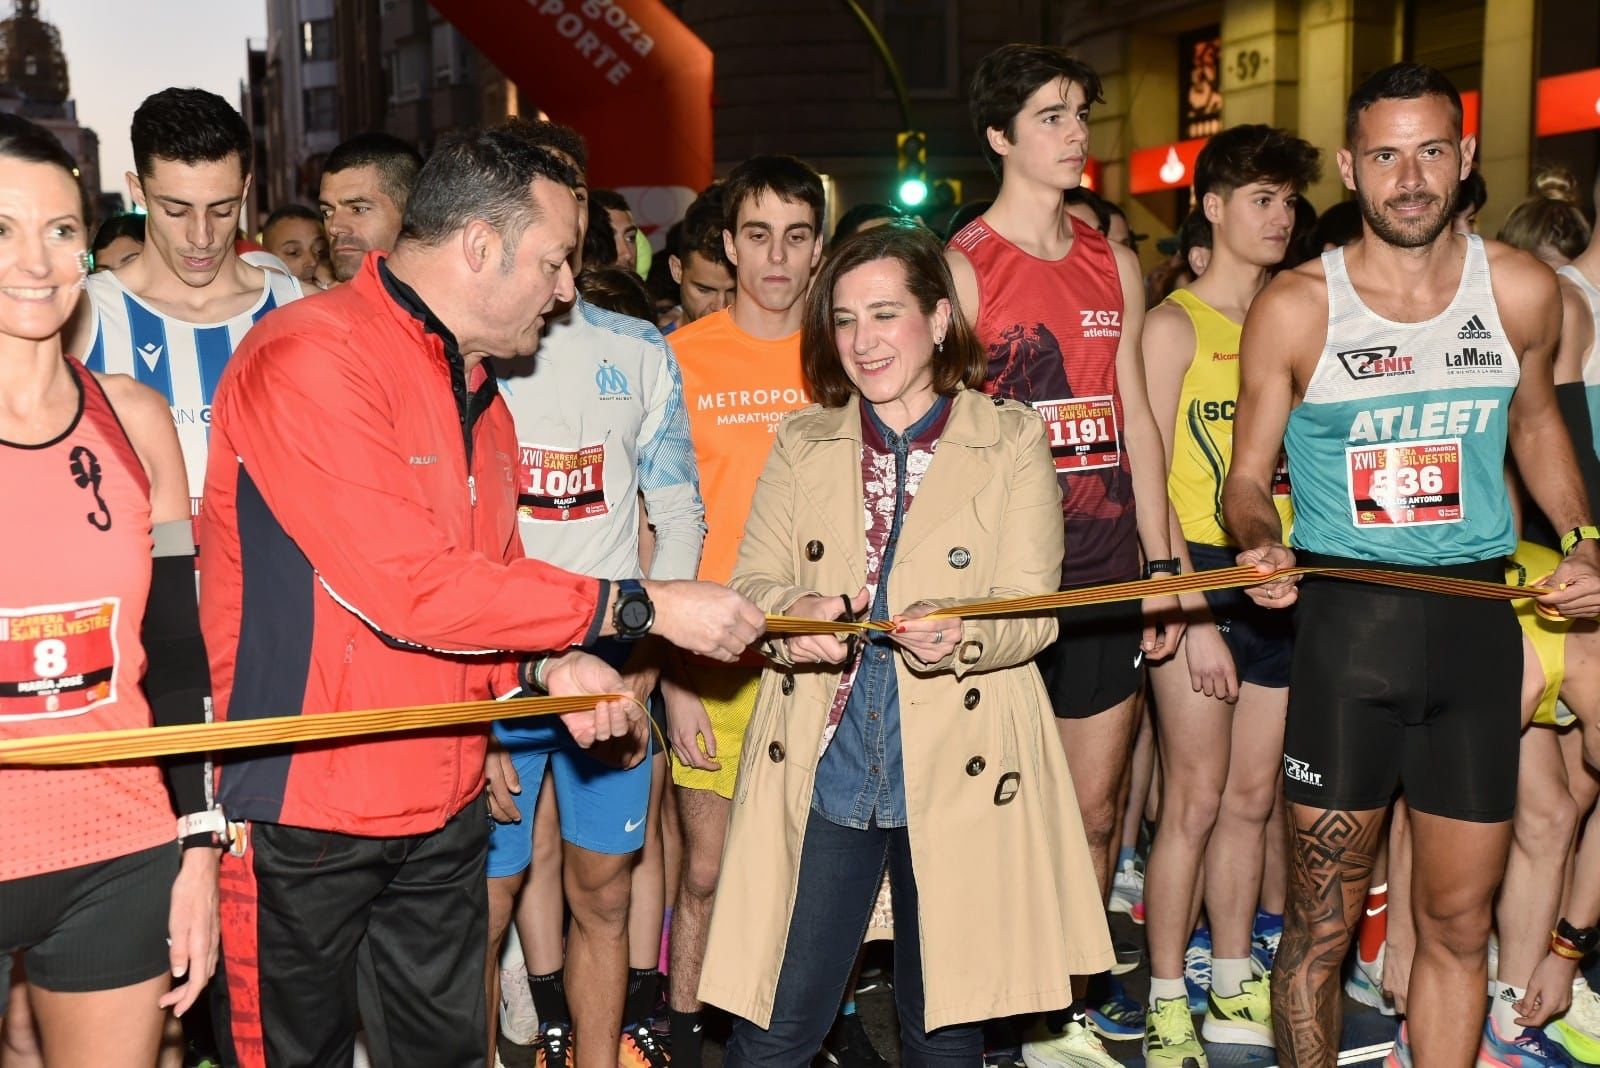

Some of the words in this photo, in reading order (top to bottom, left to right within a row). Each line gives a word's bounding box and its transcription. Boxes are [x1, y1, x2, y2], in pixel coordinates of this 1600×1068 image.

[1236, 49, 1261, 81] 59
[1080, 310, 1120, 326] ZGZ
[1457, 330, 1492, 340] adidas
[1060, 410, 1076, 420] SAN
[1076, 407, 1112, 419] SILVESTRE
[1349, 400, 1500, 443] ATLEET
[1050, 417, 1109, 447] 1191
[522, 449, 543, 467] XVII
[544, 452, 578, 461] CARRERA
[544, 459, 564, 469] SAN
[565, 453, 603, 469] SILESTRE
[1354, 451, 1377, 470] XVII
[1402, 452, 1457, 466] SILVESTRE
[527, 465, 596, 497] 1001
[1372, 465, 1443, 496] 536
[1408, 495, 1443, 504] ANTONIO
[11, 626, 41, 641] SAN
[43, 615, 111, 639] SILVESTRE
[33, 638, 68, 678] 8
